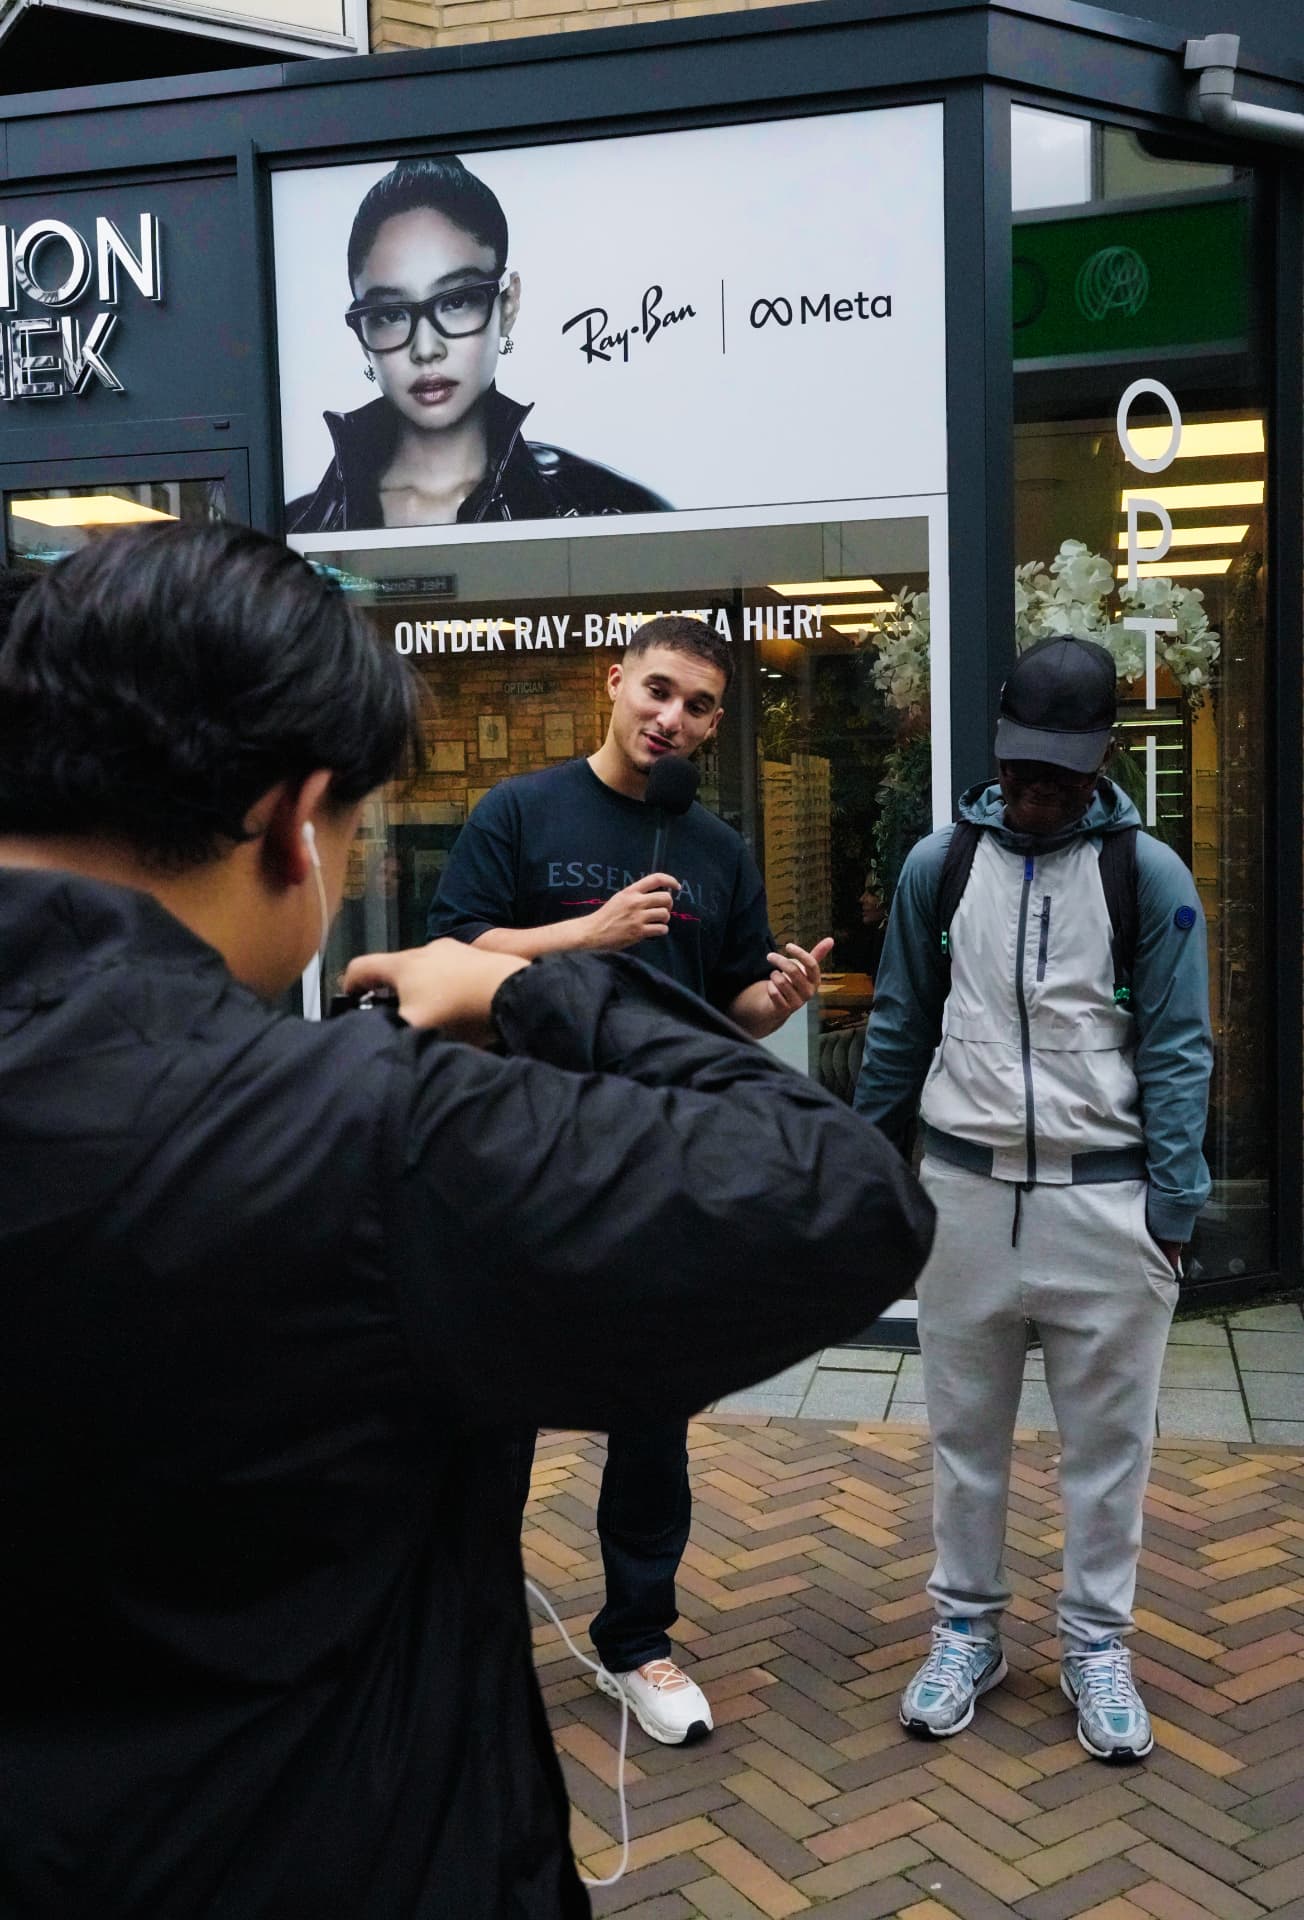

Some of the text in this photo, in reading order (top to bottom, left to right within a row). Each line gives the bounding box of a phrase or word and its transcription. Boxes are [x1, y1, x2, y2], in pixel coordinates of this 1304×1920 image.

[801, 292, 892, 325] Meta
[394, 618, 505, 655] ONTDEK
[743, 604, 823, 641] HIER!
[548, 861, 719, 914] ESSENALS
